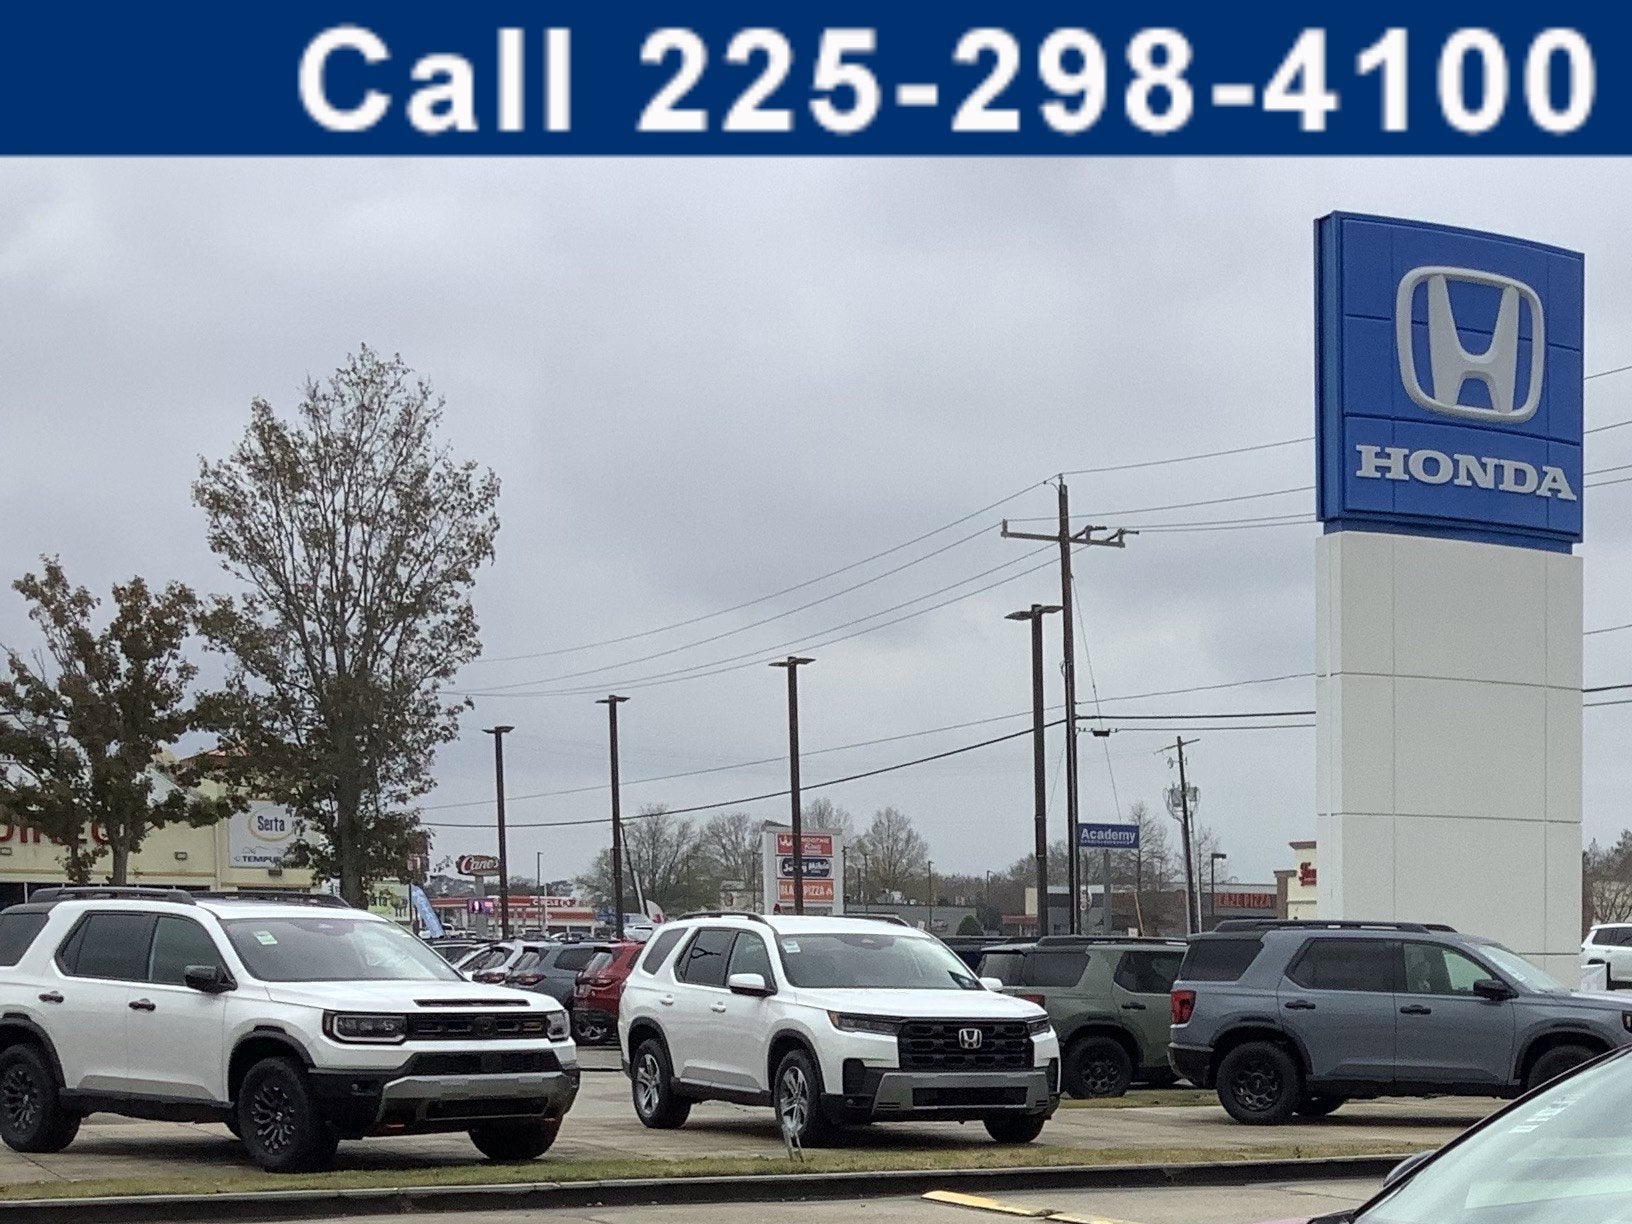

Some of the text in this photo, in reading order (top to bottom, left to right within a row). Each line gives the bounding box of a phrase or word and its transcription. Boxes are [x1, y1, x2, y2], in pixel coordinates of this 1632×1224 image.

[1355, 444, 1578, 502] HONDA
[257, 815, 285, 831] Serta
[1081, 828, 1136, 844] Academy
